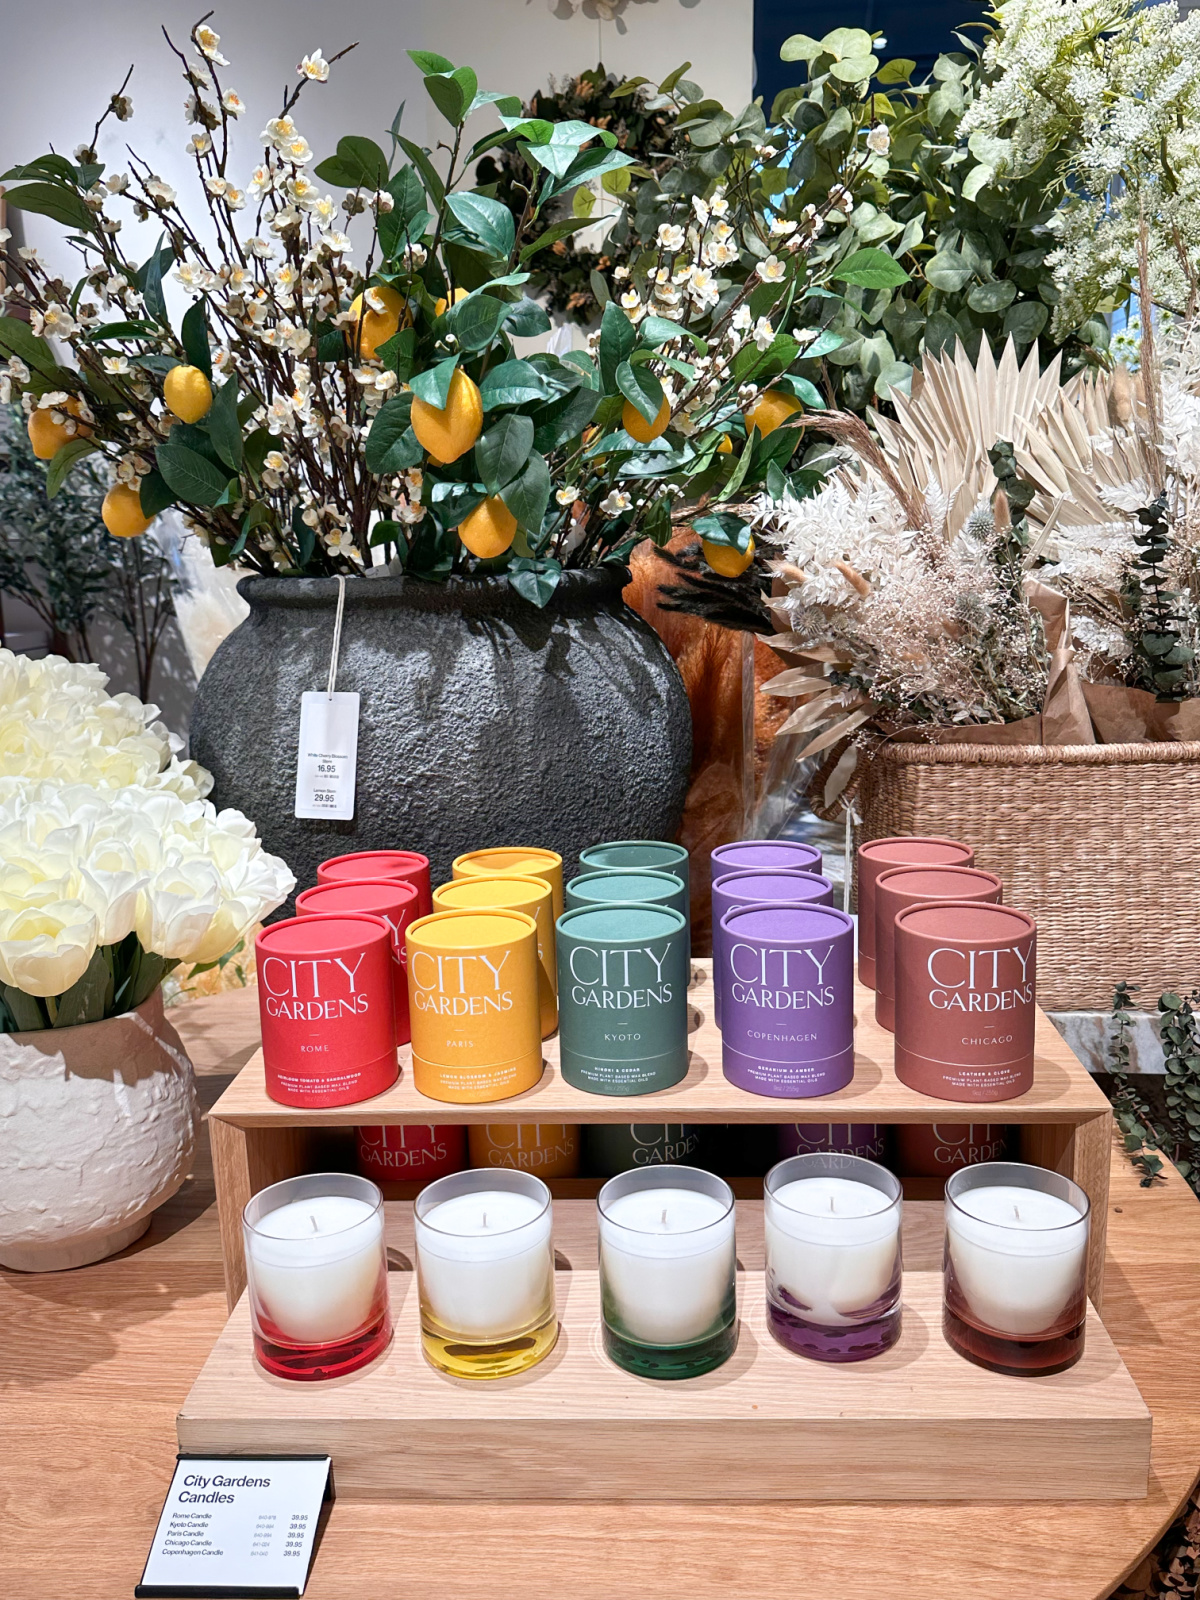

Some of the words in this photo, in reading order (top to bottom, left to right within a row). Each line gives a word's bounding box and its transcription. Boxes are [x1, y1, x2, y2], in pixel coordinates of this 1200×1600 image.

[314, 794, 334, 802] 29.95
[263, 952, 366, 998] CITY
[412, 950, 511, 994] CITY
[570, 942, 672, 987] CITY
[730, 944, 834, 988] CITY
[928, 940, 1033, 989] CITY
[266, 994, 368, 1020] GARDENS
[414, 991, 512, 1016] GARDENS
[572, 983, 672, 1009] GARDENS
[732, 983, 834, 1010] GARDENS
[929, 982, 1032, 1012] GARDENS
[604, 1033, 641, 1041] KYOTO
[747, 1030, 817, 1042] COPENHAGEN
[961, 1034, 1013, 1045] CHICAGO
[361, 1143, 447, 1167] GARDENS
[488, 1138, 574, 1167] GARDENS
[184, 1475, 211, 1489] City
[212, 1475, 271, 1487] Gardens
[178, 1491, 235, 1503] Candles
